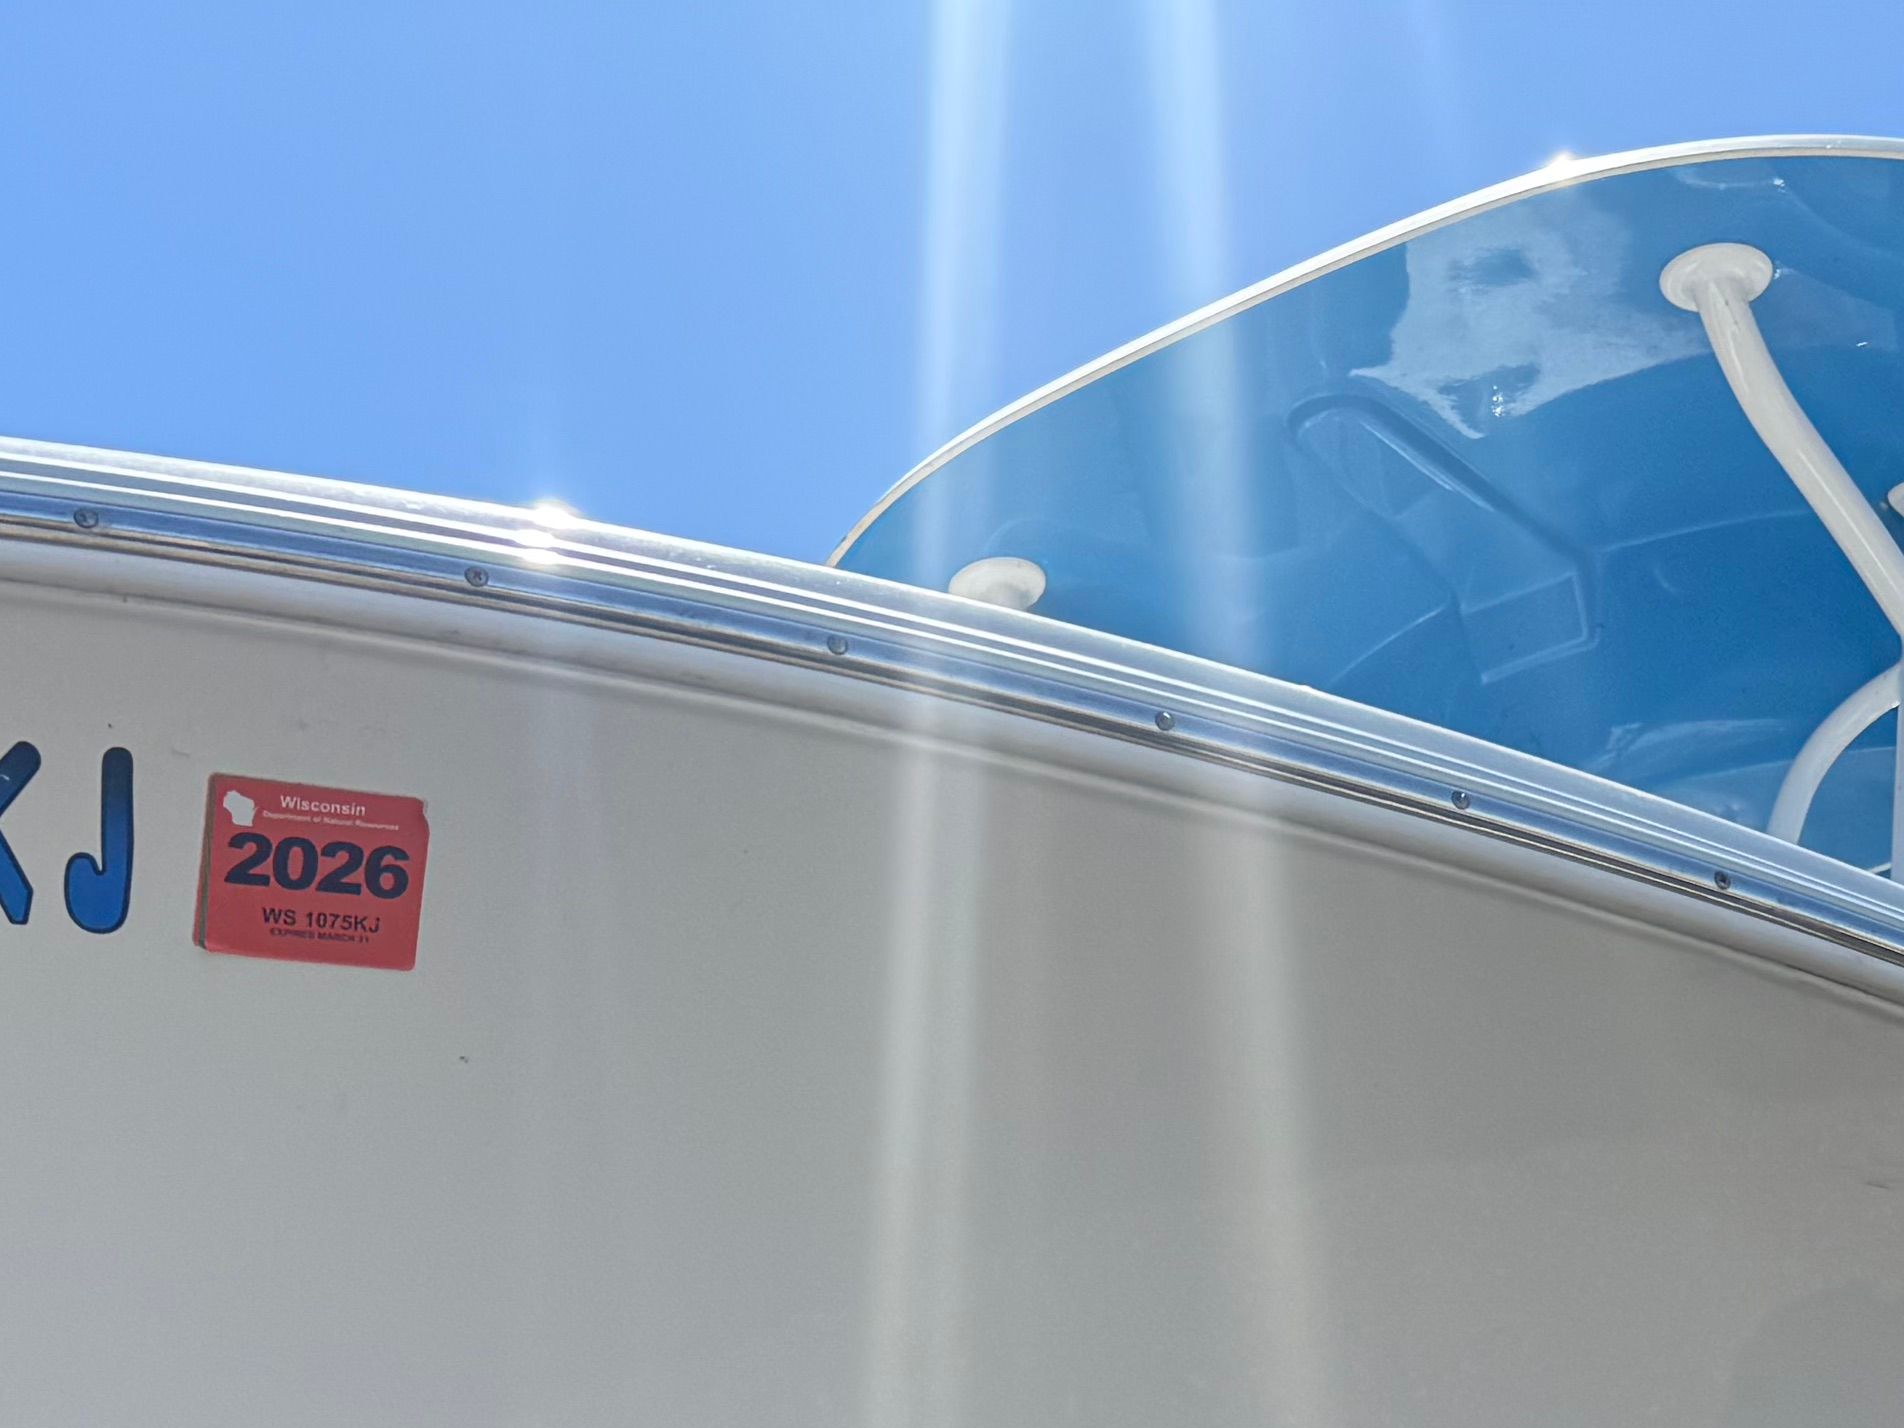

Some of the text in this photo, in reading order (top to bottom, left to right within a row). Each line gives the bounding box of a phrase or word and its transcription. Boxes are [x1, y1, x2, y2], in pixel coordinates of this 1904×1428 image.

[280, 794, 366, 816] Wisconsin
[262, 809, 311, 822] Department
[323, 816, 354, 827] Natural
[223, 831, 410, 899] 2026
[261, 906, 381, 933] WS 1075KJ
